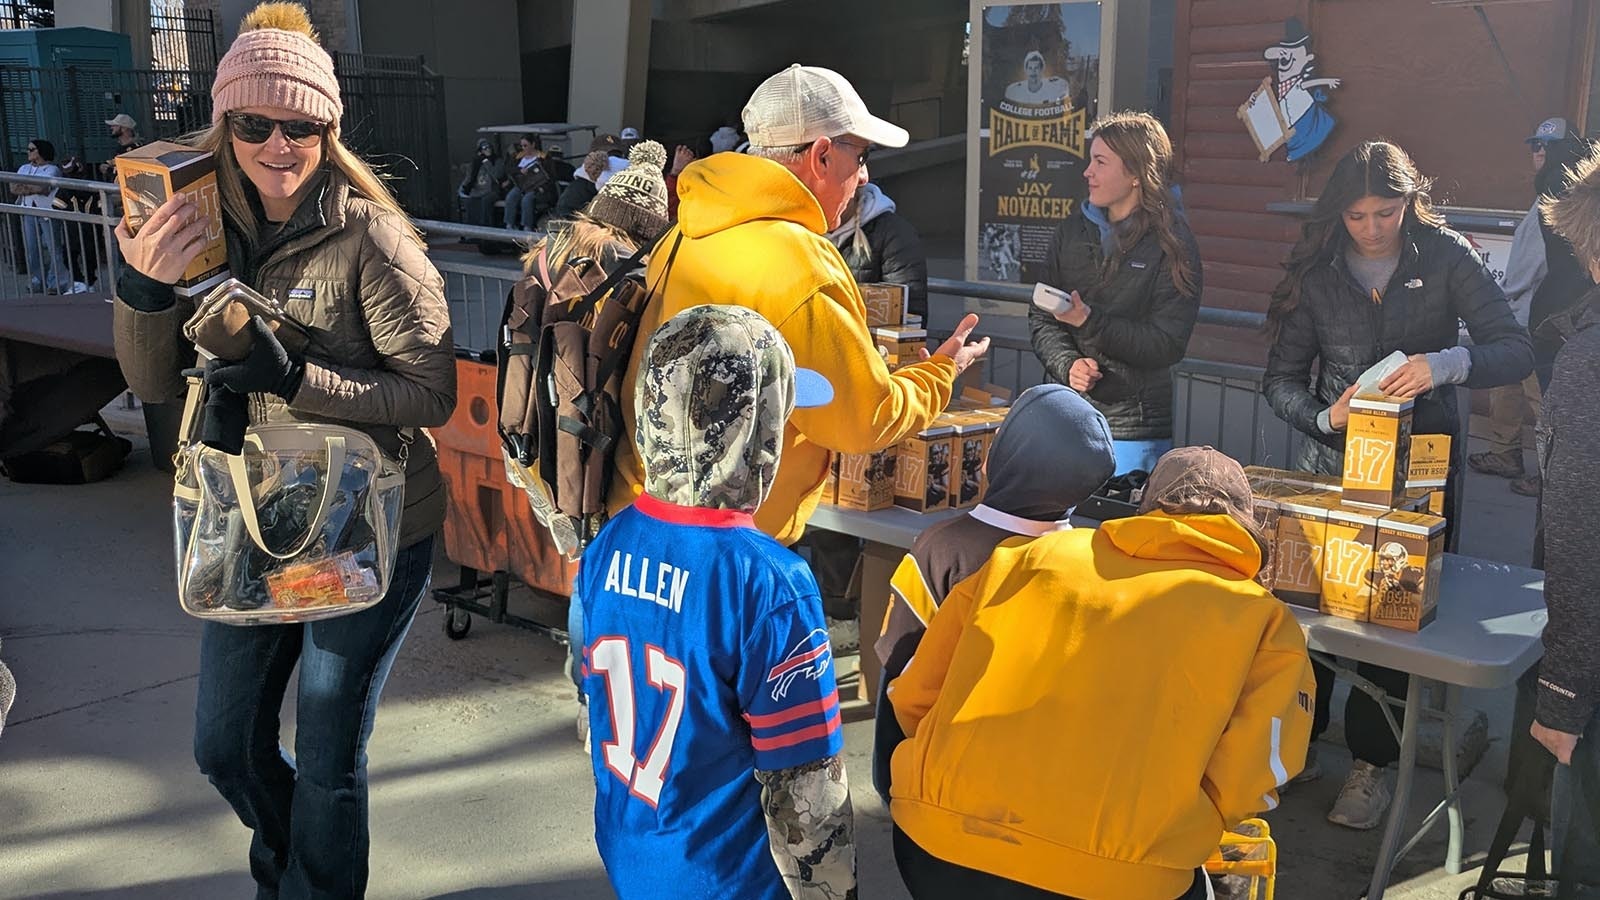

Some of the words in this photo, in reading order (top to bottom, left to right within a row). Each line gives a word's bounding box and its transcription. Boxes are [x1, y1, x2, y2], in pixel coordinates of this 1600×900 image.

[1000, 101, 1032, 116] COLLEGE
[1034, 102, 1073, 117] FOOTBALL
[994, 115, 1030, 150] HALL
[1032, 125, 1039, 138] OF
[1041, 115, 1080, 152] FAME
[1017, 183, 1052, 196] JAY
[997, 196, 1074, 219] NOVACEK
[841, 453, 867, 484] 17
[896, 454, 925, 493] 17
[1346, 436, 1394, 484] 17
[1397, 530, 1424, 541] RETIREMENT
[1279, 539, 1323, 587] 17
[1325, 537, 1373, 587] 17
[604, 550, 690, 613] ALLEN
[1380, 589, 1411, 604] JOSH
[1375, 605, 1416, 621] ALLEN
[589, 635, 687, 810] 17
